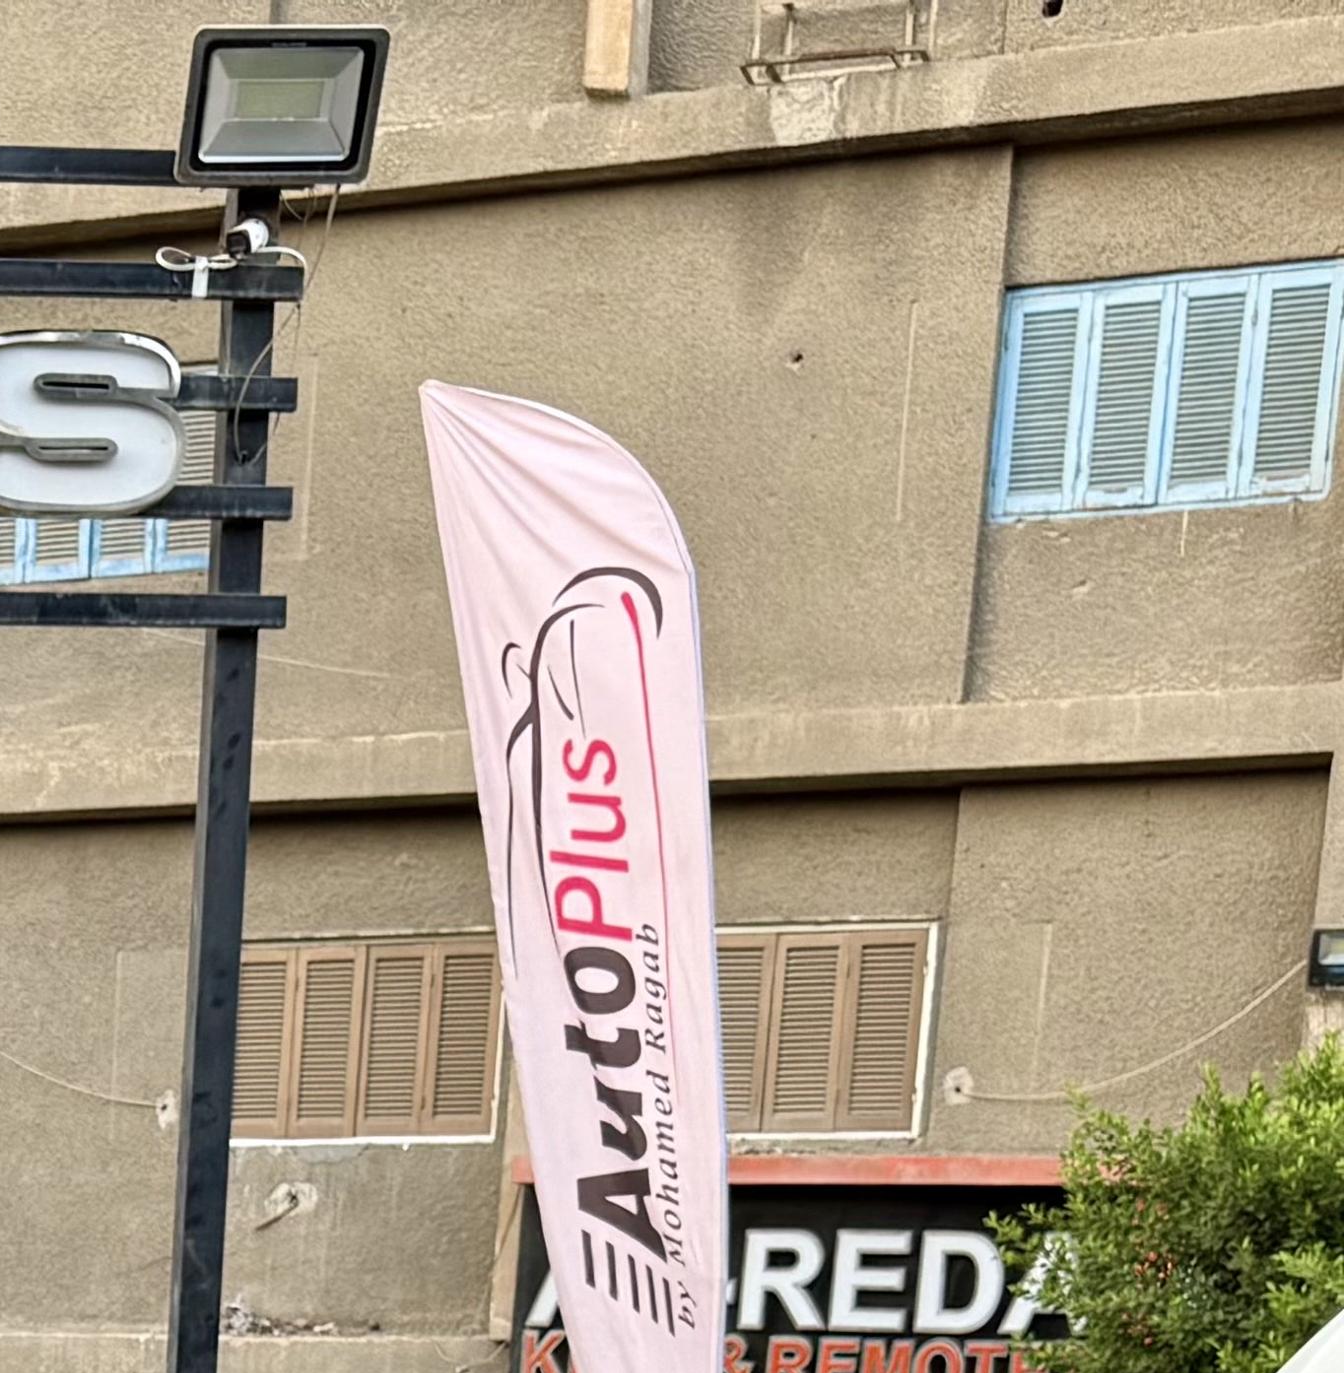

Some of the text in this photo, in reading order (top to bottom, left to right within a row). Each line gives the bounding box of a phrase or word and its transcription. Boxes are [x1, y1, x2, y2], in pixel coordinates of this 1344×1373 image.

[635, 922, 698, 1330] by Mohamed Ragab
